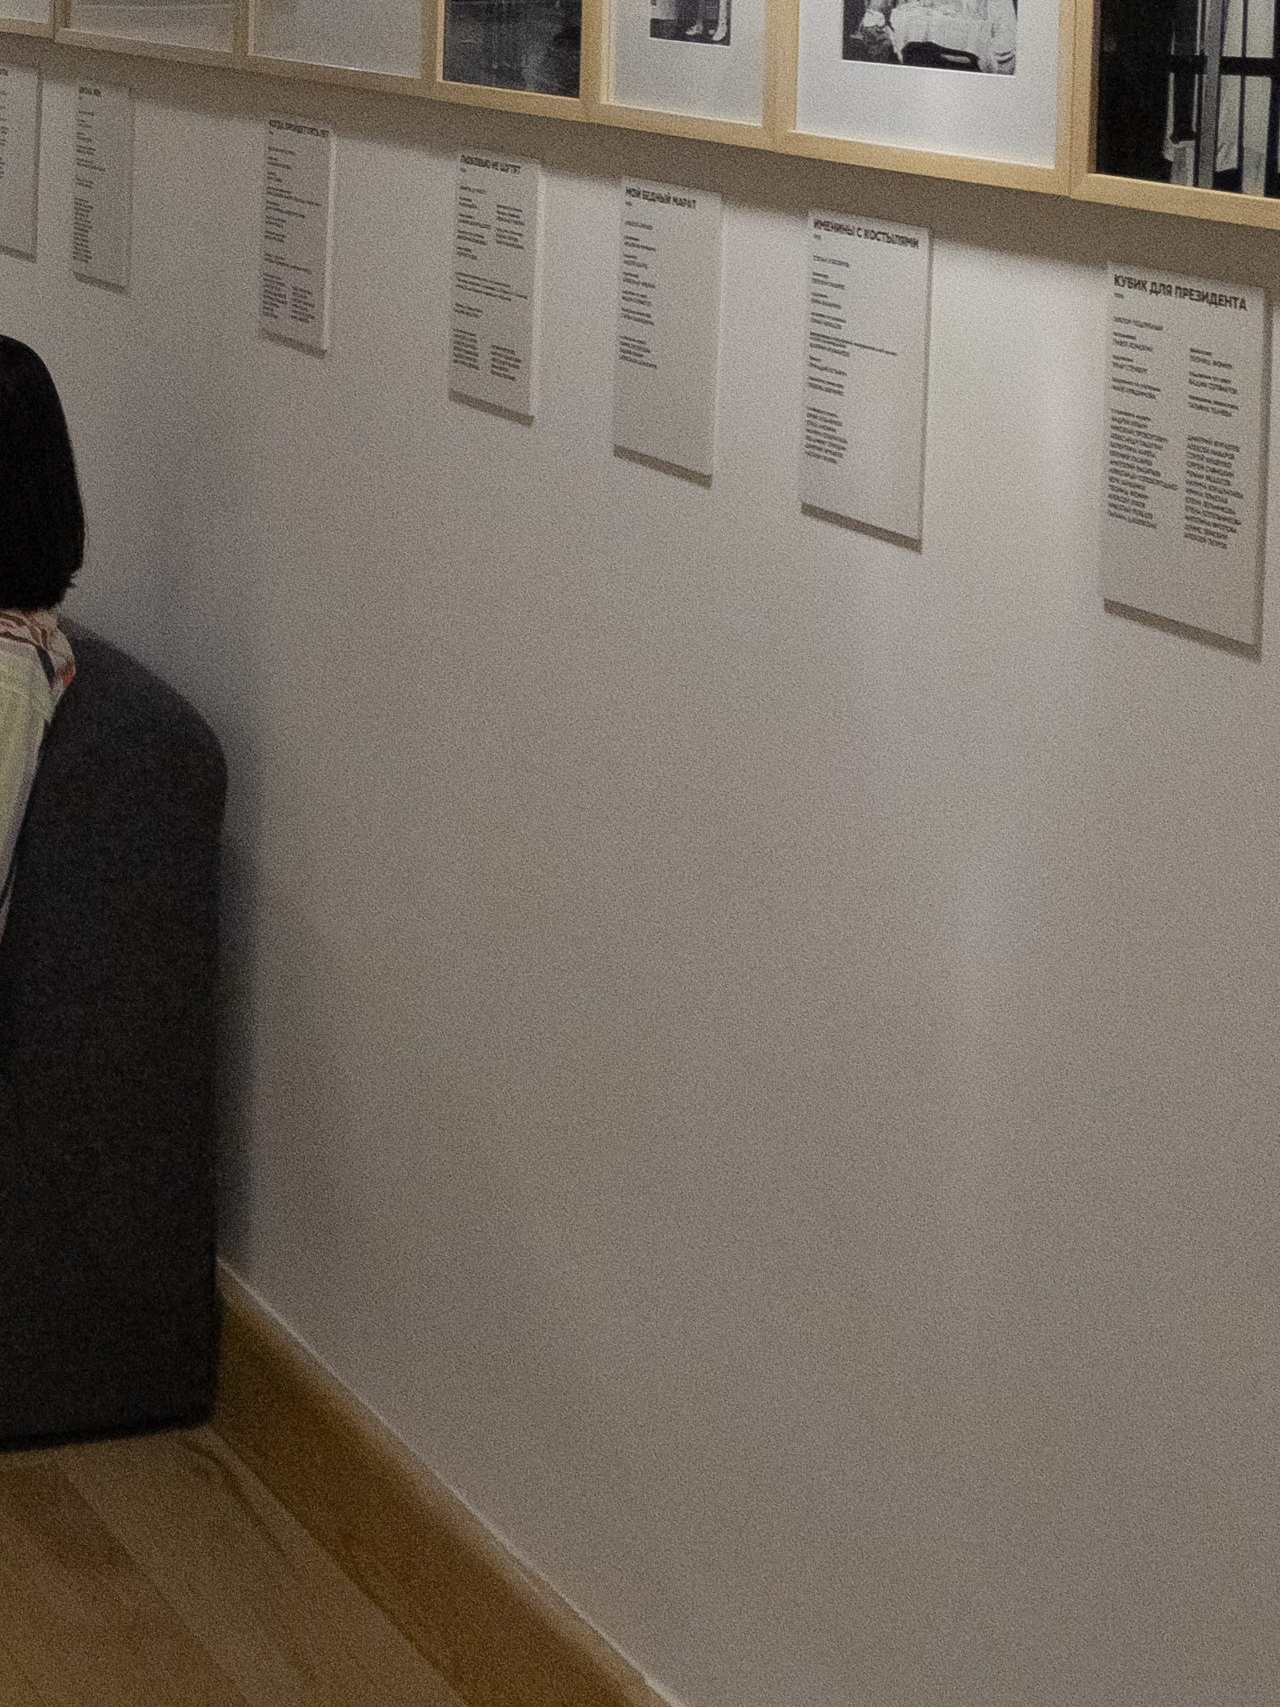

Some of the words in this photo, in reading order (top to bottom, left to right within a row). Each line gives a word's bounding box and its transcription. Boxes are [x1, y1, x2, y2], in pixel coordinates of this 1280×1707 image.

[1113, 274, 1148, 292] КУБИК
[1149, 281, 1173, 297] ДЛЯ
[1174, 286, 1248, 312] ПРЕЗИДЕНТА
